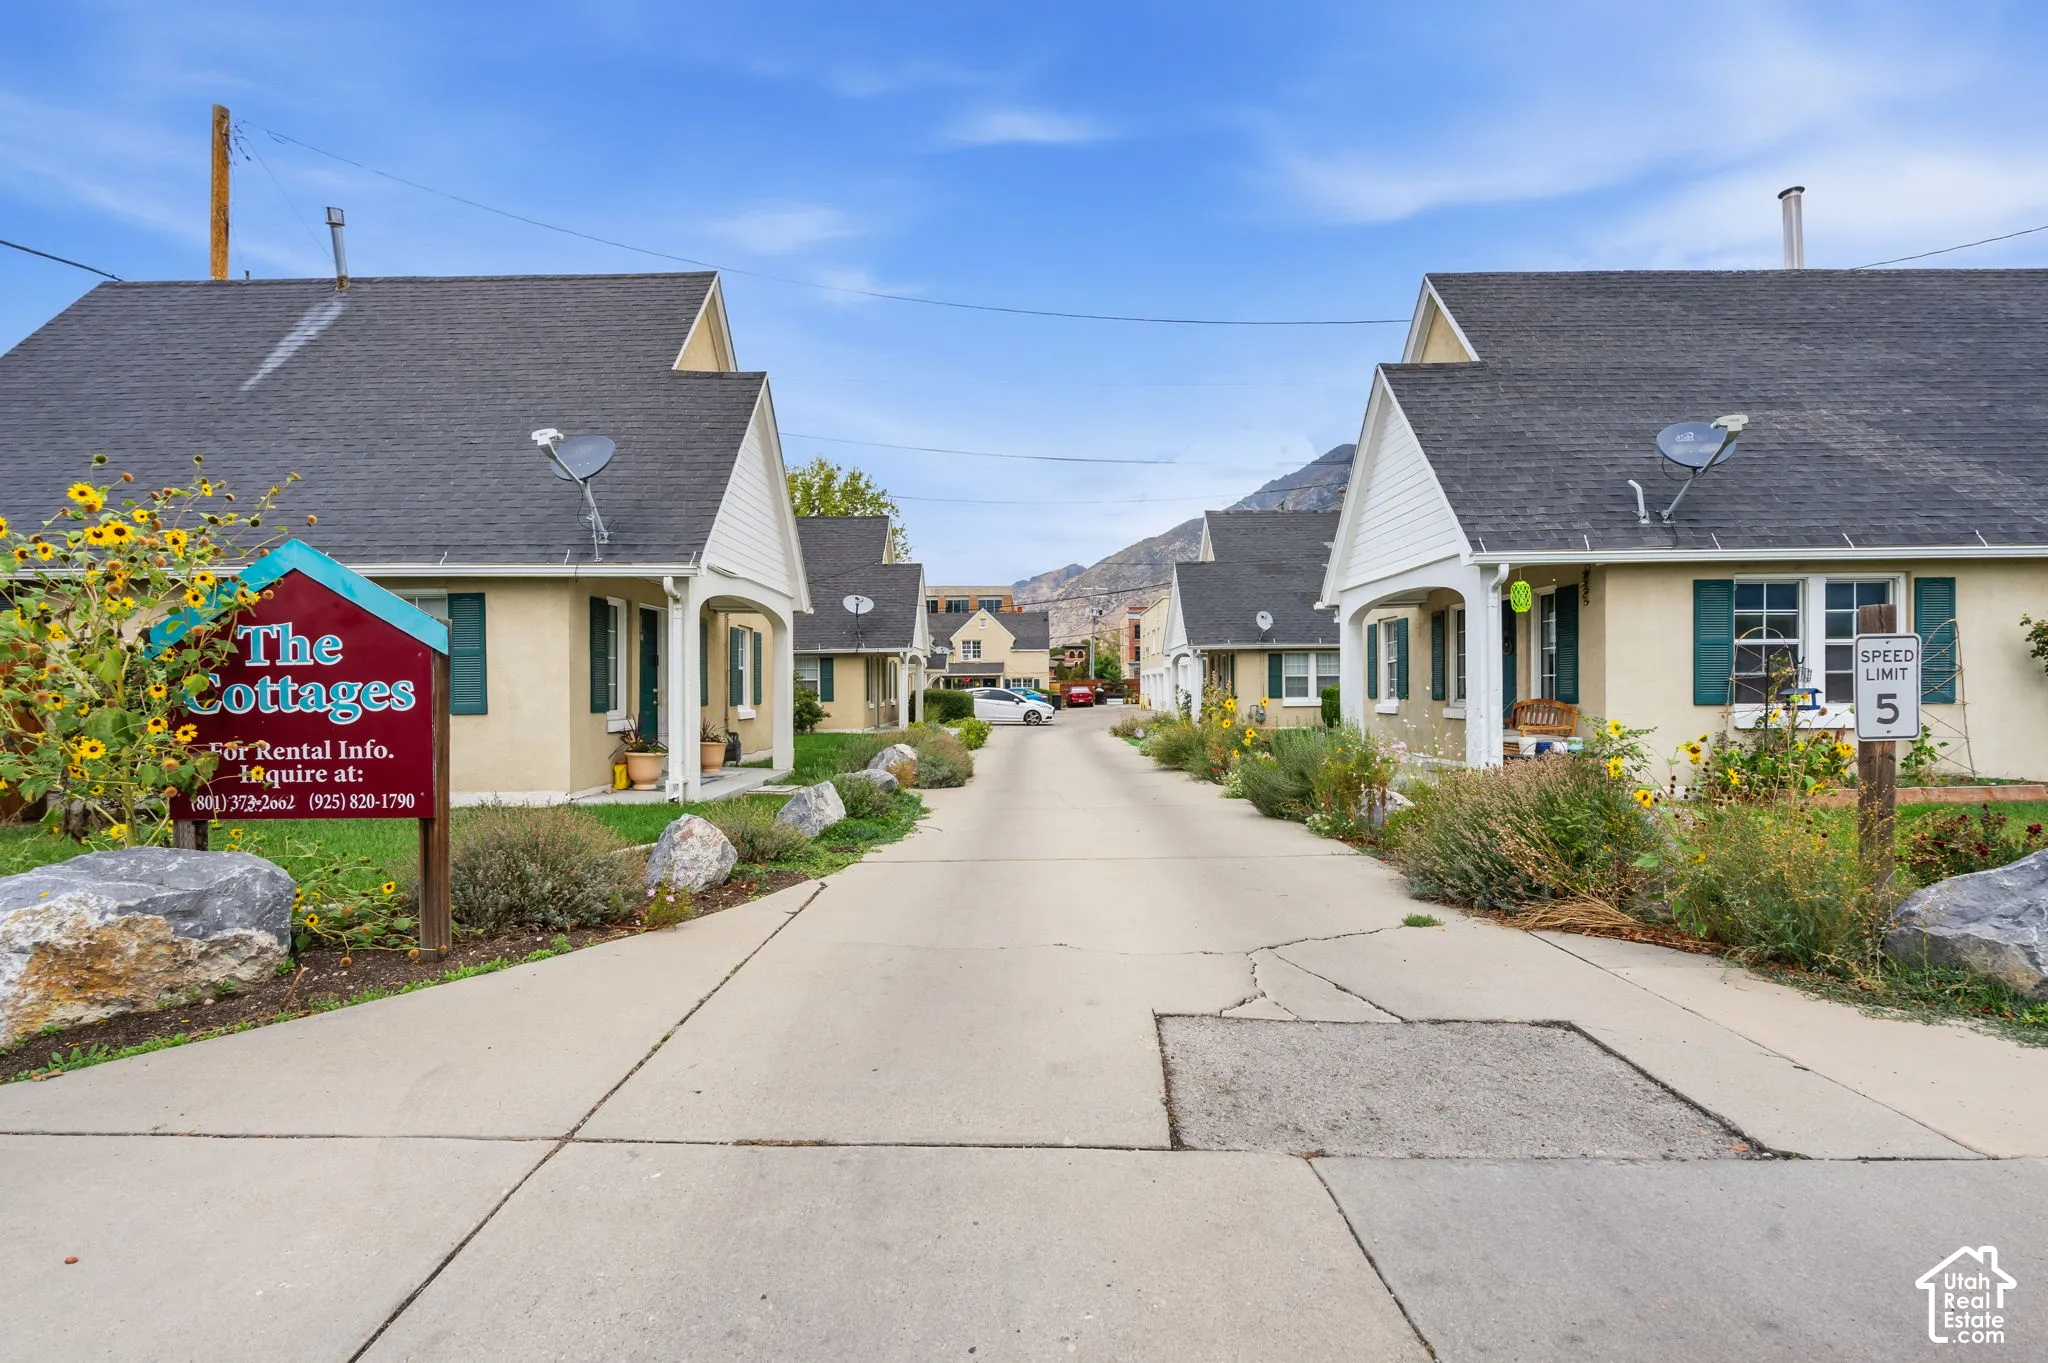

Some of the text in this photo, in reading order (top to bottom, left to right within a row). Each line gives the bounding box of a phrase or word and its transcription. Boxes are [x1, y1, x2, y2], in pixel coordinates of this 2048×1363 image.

[236, 621, 344, 666] The
[1860, 649, 1914, 663] SPEED
[1866, 667, 1908, 681] LIMIT
[183, 673, 416, 725] Cottages
[1876, 693, 1900, 725] 5
[208, 739, 395, 761] For Rental Info.
[334, 765, 364, 783] at:
[191, 793, 227, 812] (801)
[309, 792, 346, 811] (925)
[349, 793, 415, 810] 820-1790
